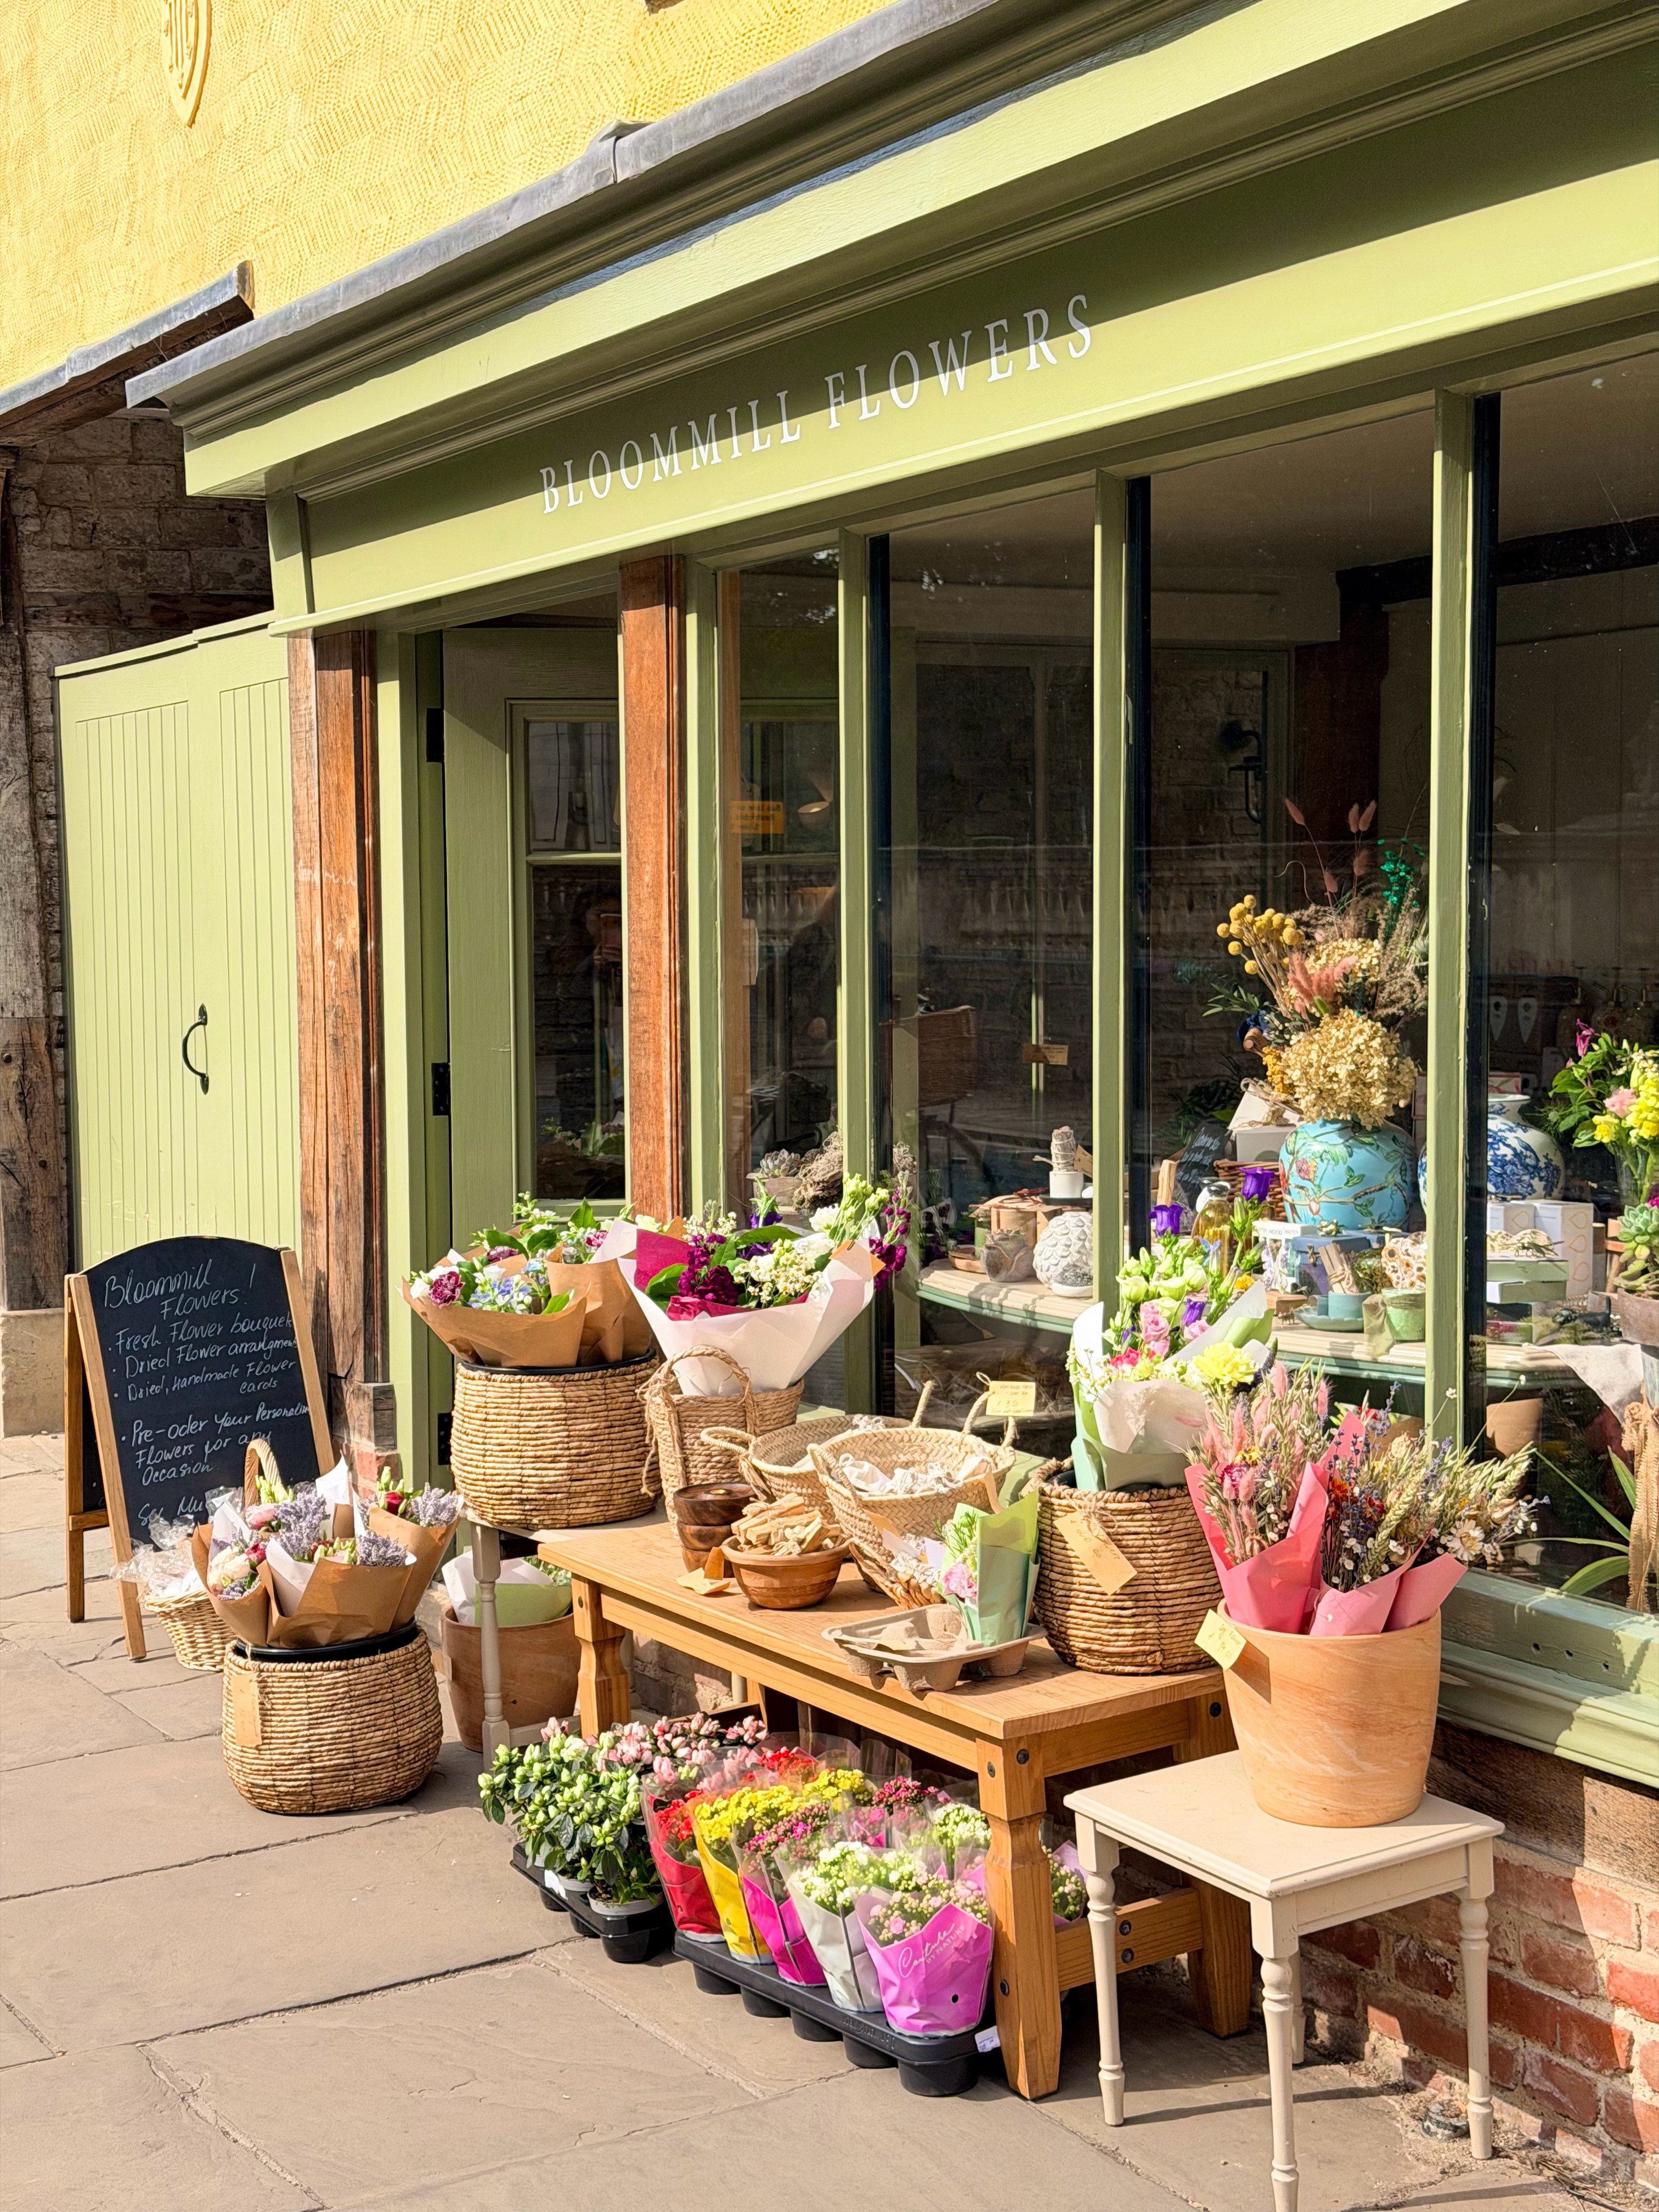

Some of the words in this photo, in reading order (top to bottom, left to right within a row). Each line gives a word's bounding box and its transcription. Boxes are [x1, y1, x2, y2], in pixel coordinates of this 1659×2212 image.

[539, 390, 800, 514] BLOOMMILL
[825, 295, 1092, 429] FLOWERS
[104, 1258, 212, 1308] Bloommill
[125, 1346, 171, 1379] Dried
